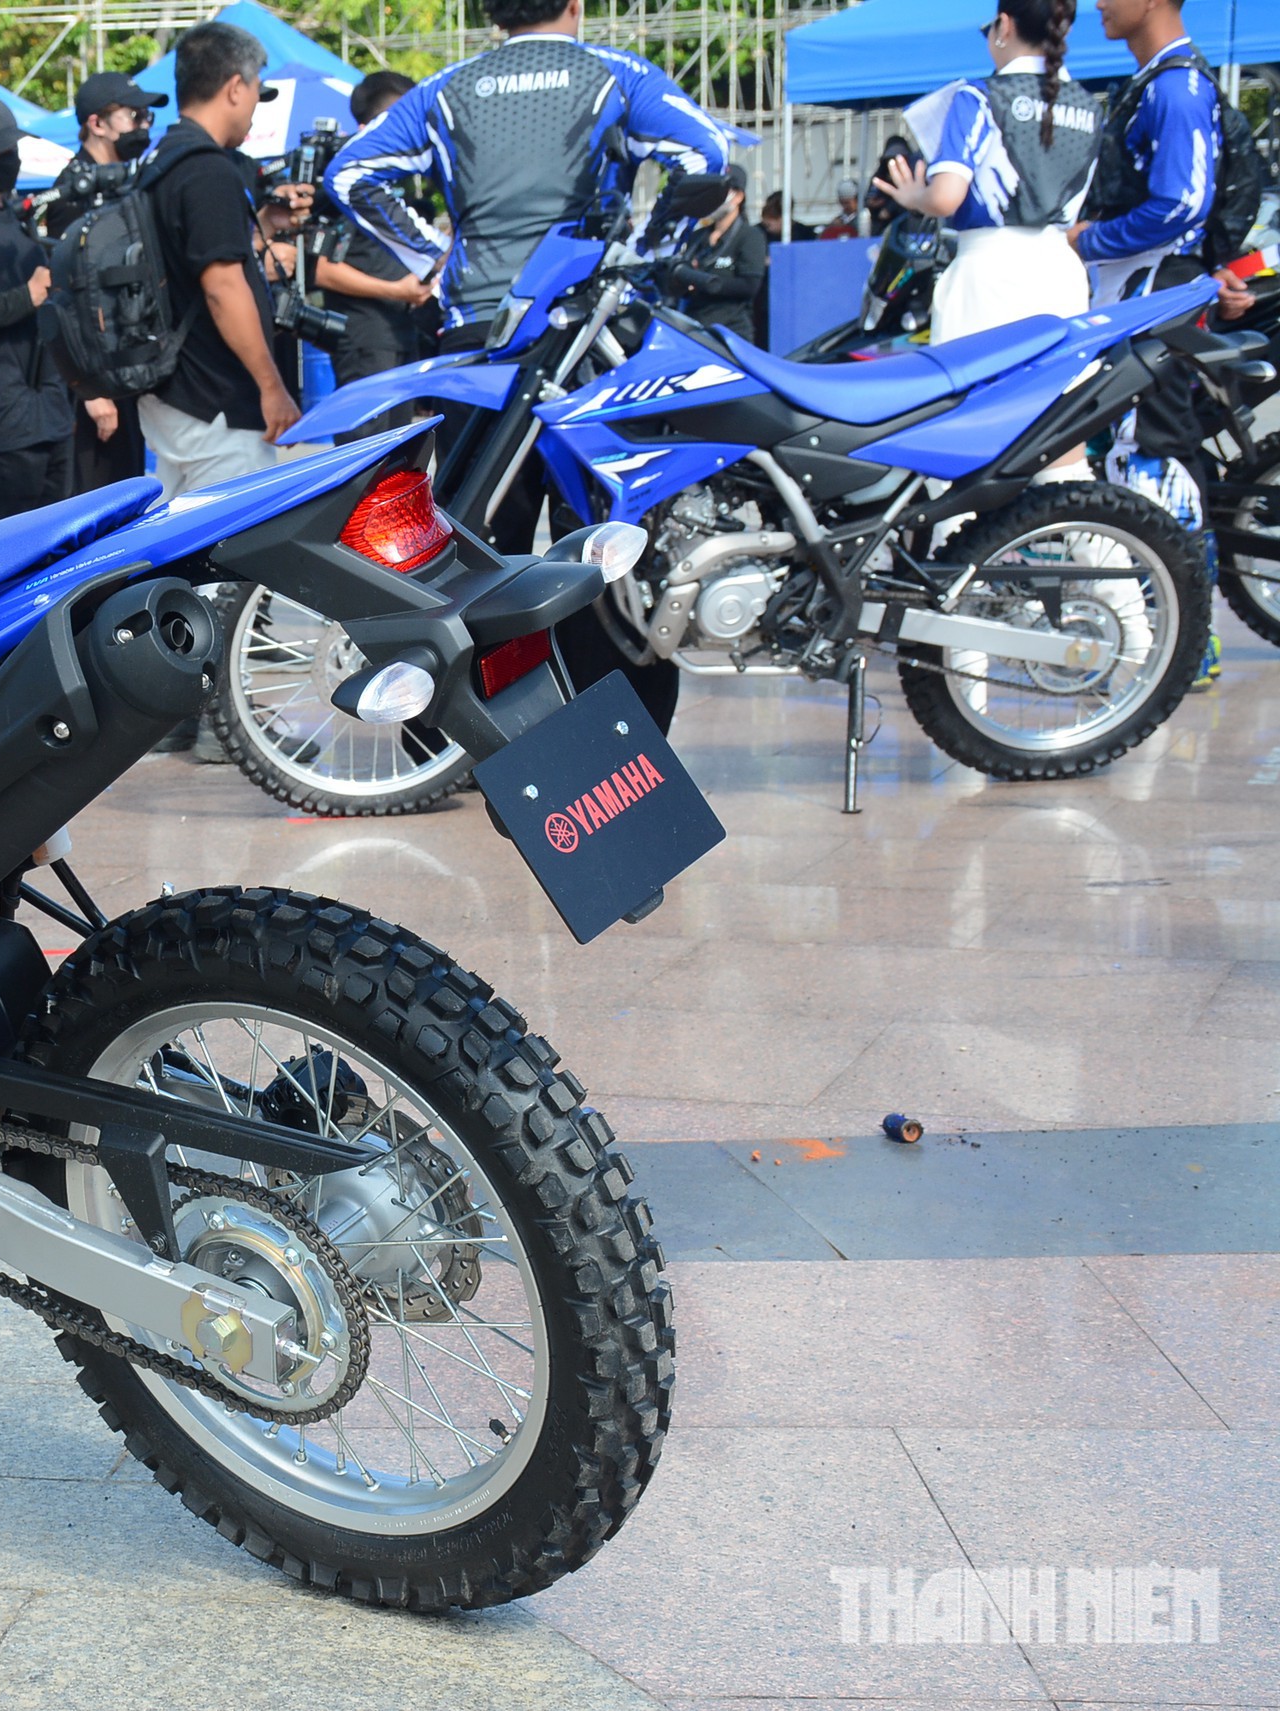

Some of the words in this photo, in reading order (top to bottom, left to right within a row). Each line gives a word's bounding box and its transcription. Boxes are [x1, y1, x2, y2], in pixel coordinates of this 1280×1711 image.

[497, 69, 570, 95] YAMAHA
[1033, 99, 1094, 134] YMAHA
[565, 753, 666, 836] YAMAHA
